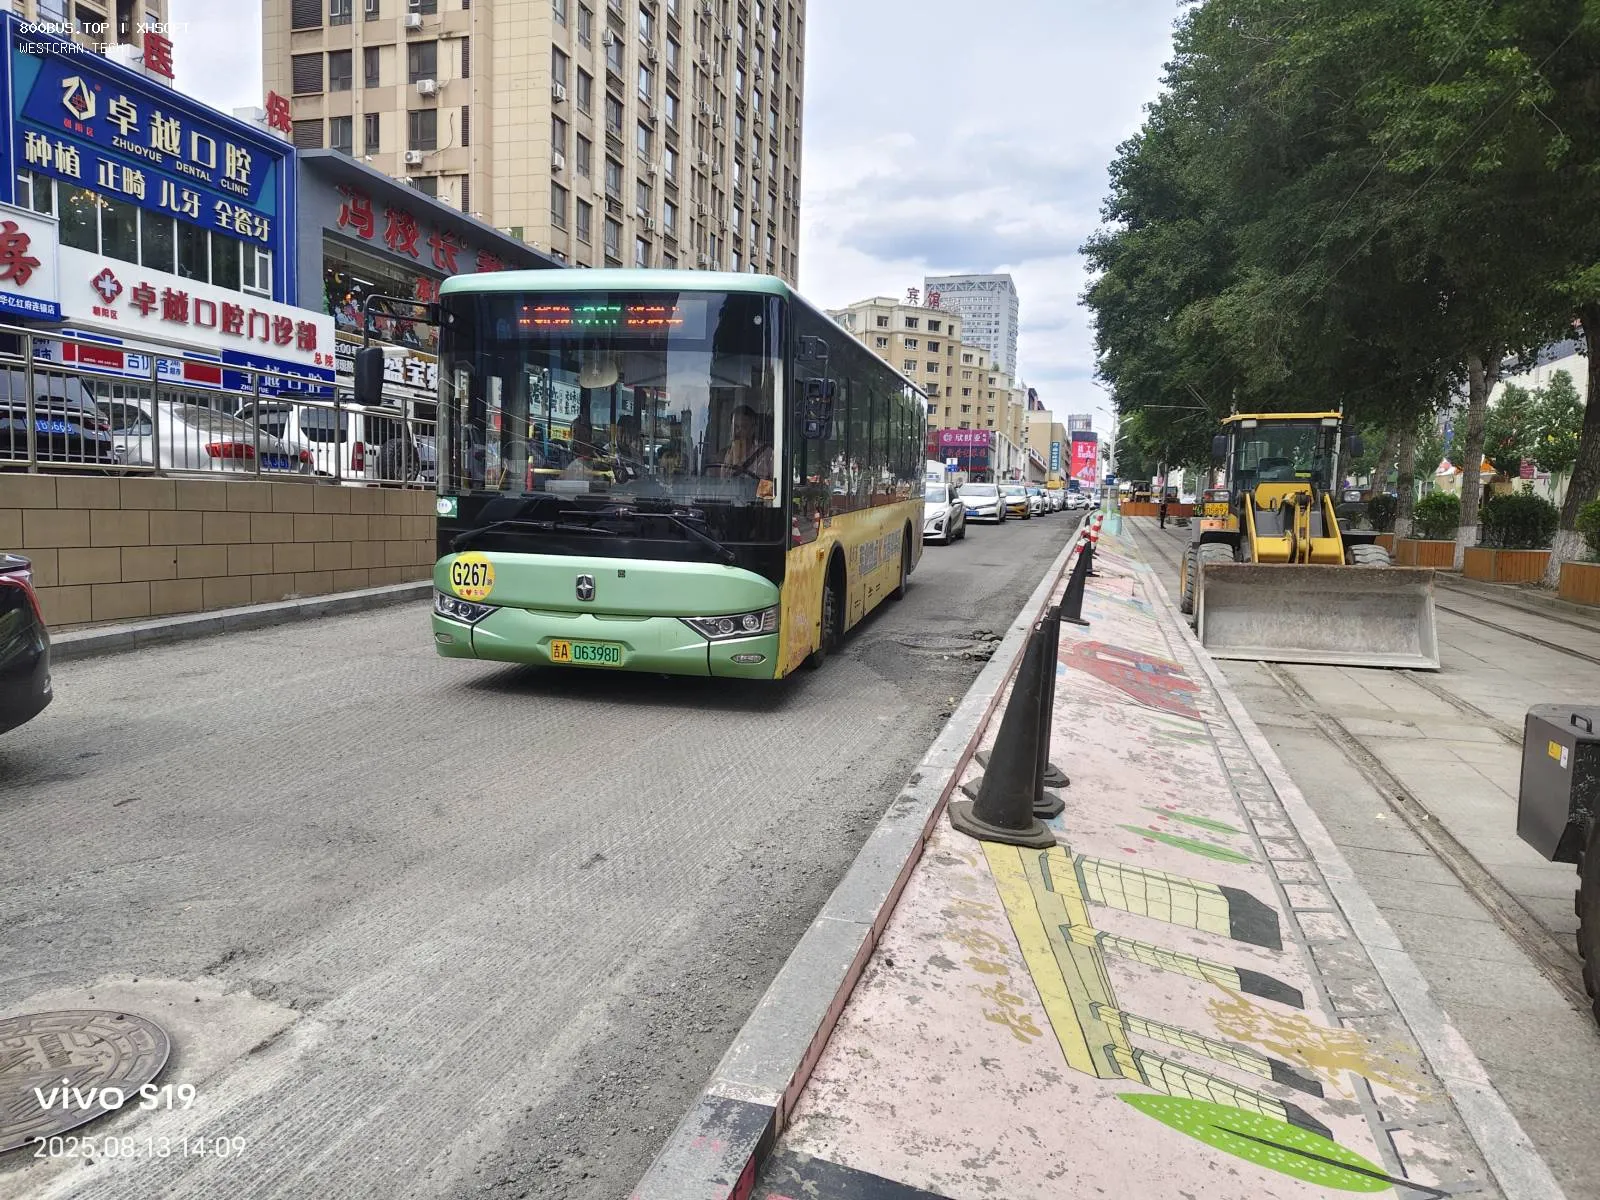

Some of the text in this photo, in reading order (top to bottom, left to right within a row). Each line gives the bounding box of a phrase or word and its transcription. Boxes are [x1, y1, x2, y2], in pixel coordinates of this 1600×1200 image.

[144, 33, 293, 133] 医 保
[106, 94, 252, 186] 卓越口腔
[112, 135, 249, 196] ZHUOYUE DENTAL CLINIC
[24, 130, 272, 242] 种植 正畸 儿牙 全瓷牙
[129, 281, 317, 351] 卓越口腔门诊部
[906, 287, 941, 309] 宾馆
[313, 352, 334, 368] 总院
[452, 561, 487, 587] G267
[553, 643, 619, 662] 吉A 06398D
